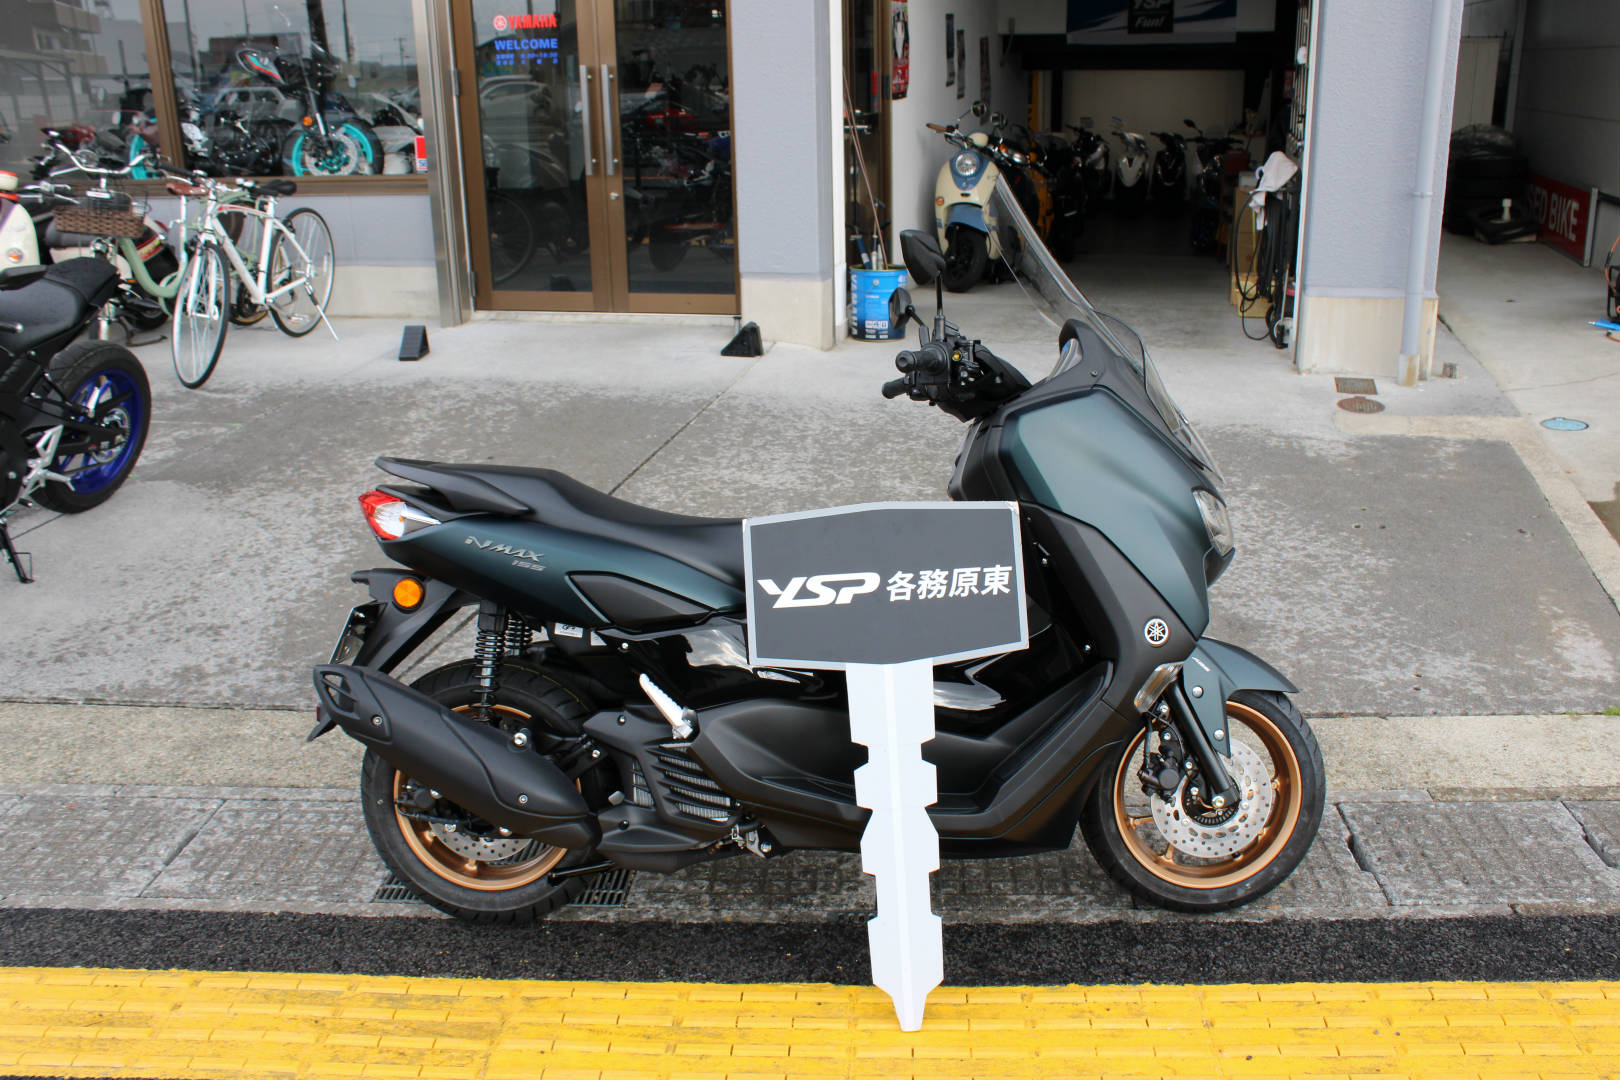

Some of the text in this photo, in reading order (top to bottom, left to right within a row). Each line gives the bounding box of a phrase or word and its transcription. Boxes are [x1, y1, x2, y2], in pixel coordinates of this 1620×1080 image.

[507, 13, 557, 29] YAMAHA
[1135, 16, 1165, 28] Fun!
[494, 38, 558, 50] WELCOME
[1549, 192, 1580, 242] BIKE
[464, 536, 544, 562] NMAX
[512, 560, 546, 571] 155
[757, 564, 1013, 609] YSP 各務原東
